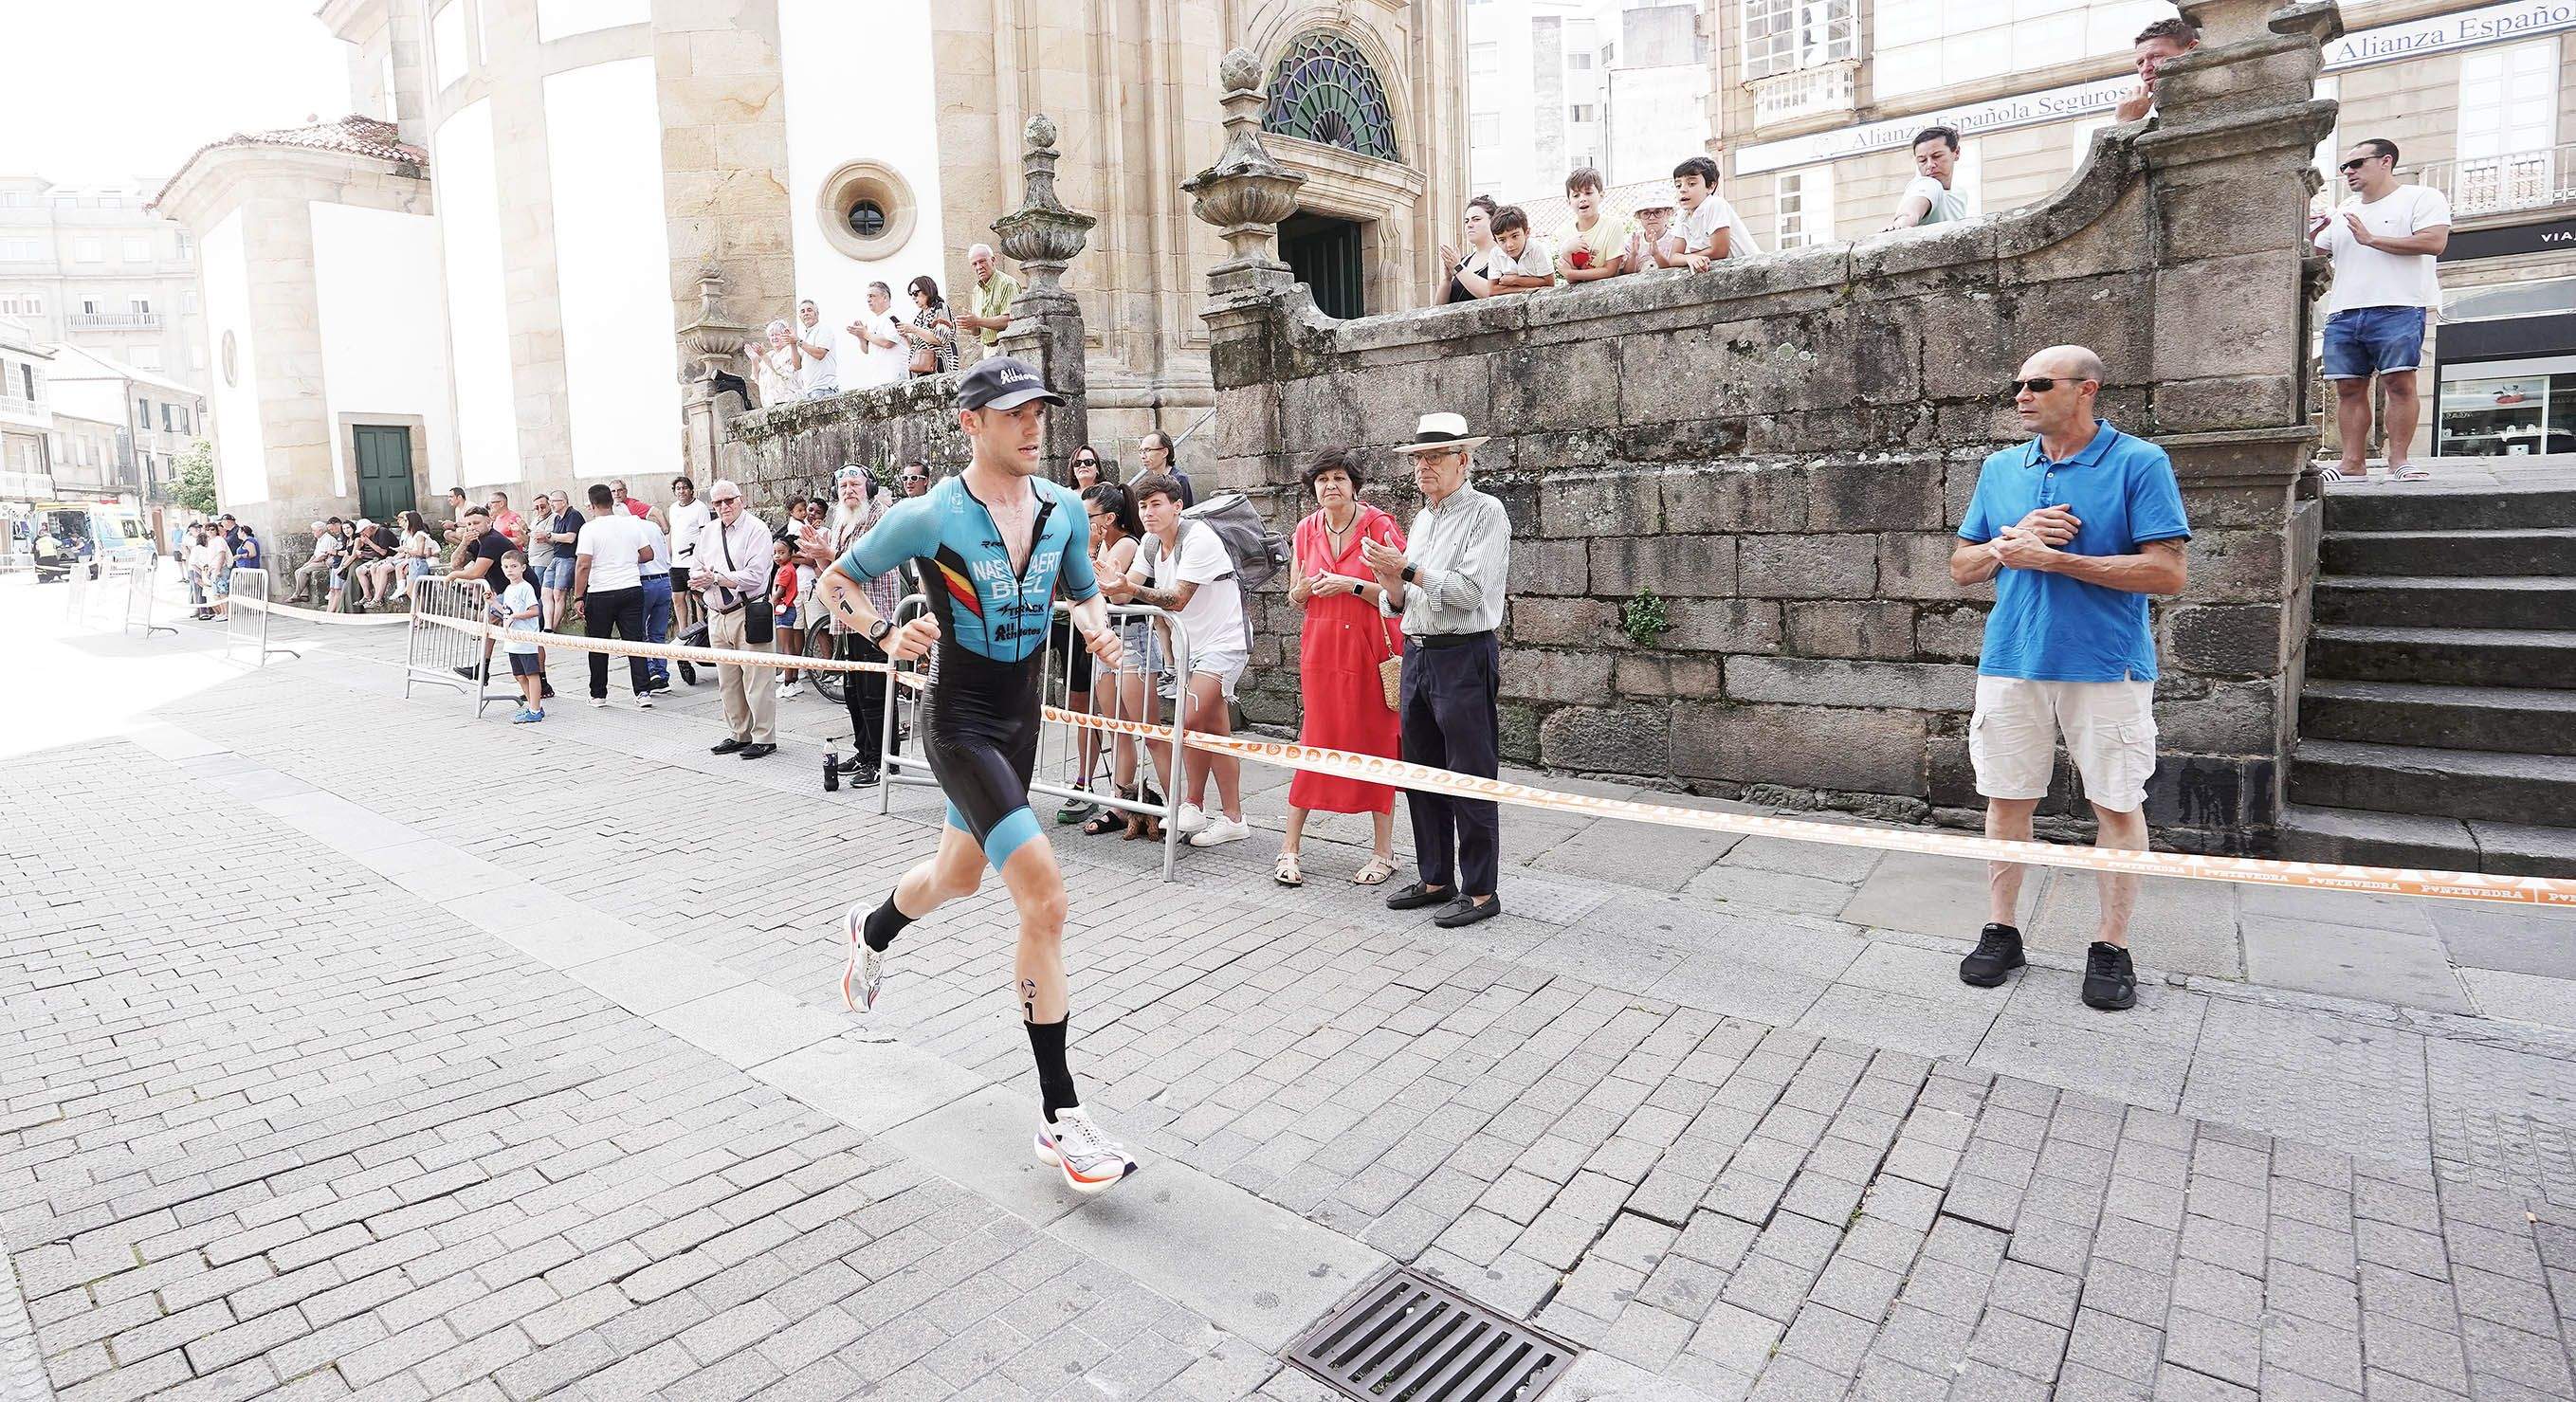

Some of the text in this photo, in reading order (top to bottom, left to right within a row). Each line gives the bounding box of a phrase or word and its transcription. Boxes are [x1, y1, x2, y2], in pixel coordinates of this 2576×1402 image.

[2337, 5, 2576, 62] Alianza Españo
[2541, 231, 2576, 243] VIA
[840, 600, 853, 615] 1
[1024, 1001, 1033, 1022] 1
